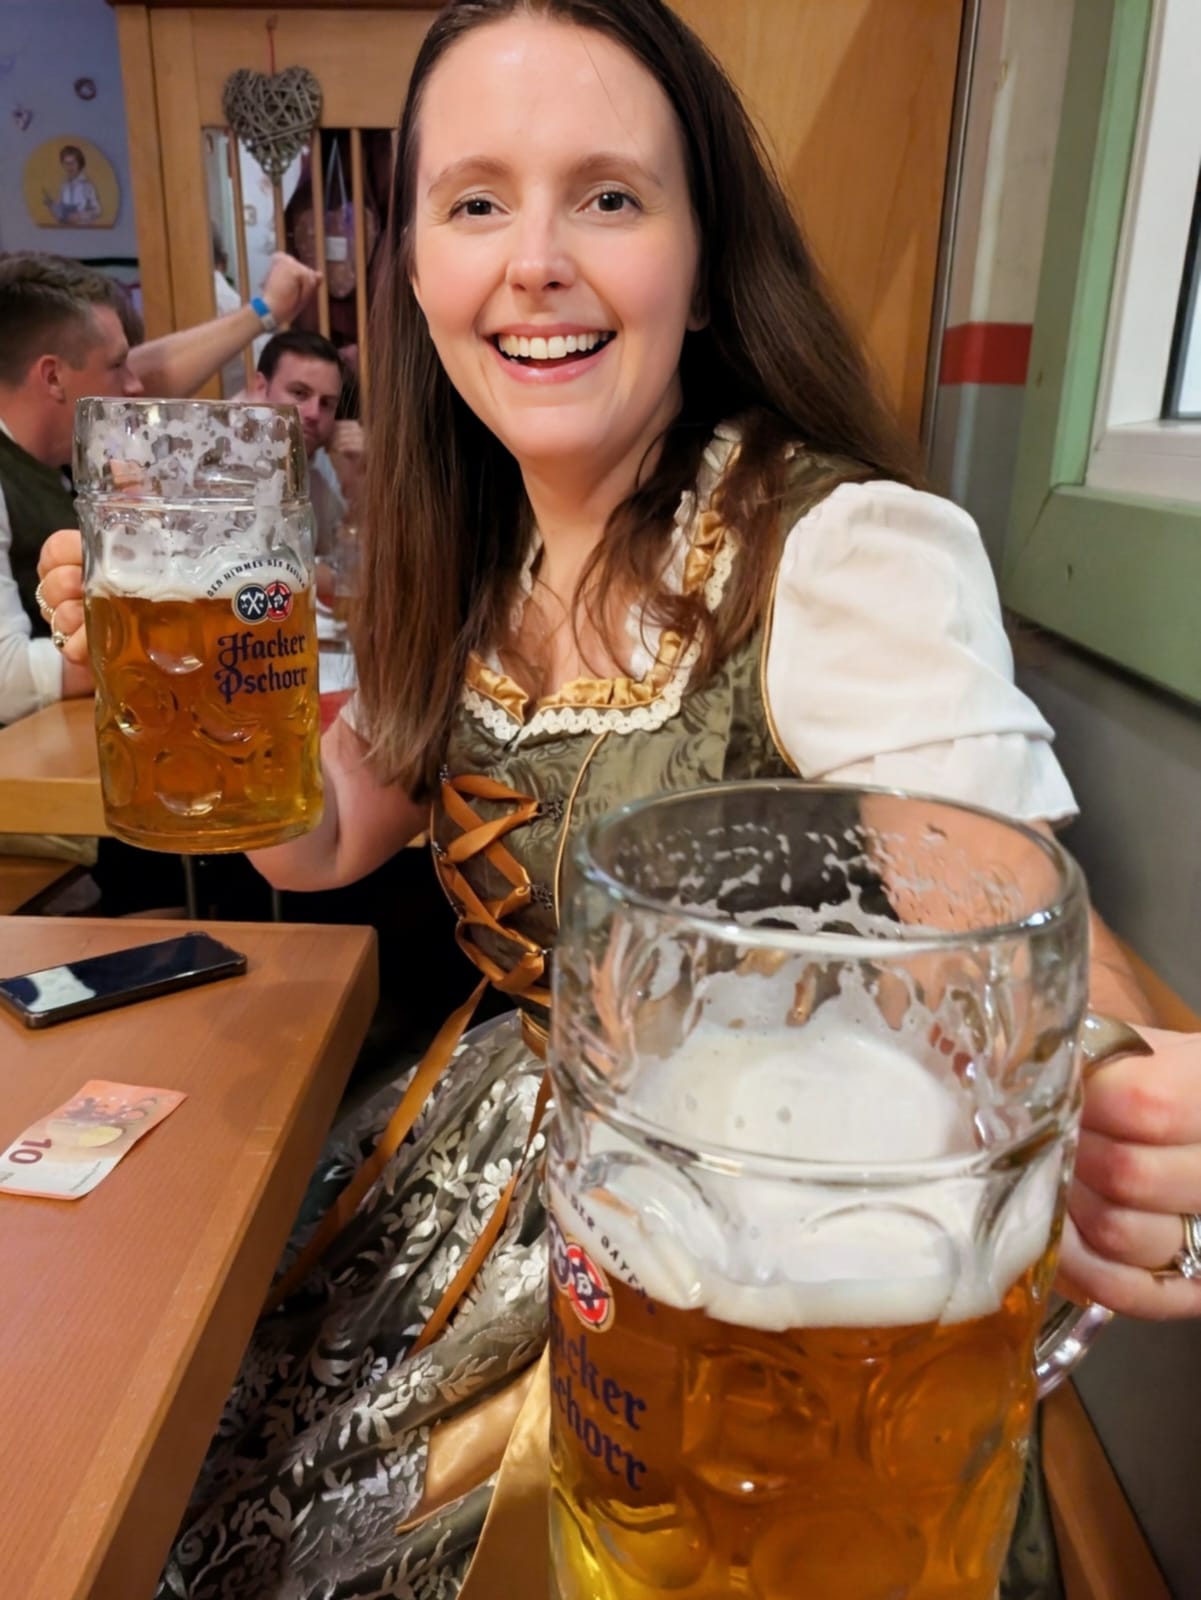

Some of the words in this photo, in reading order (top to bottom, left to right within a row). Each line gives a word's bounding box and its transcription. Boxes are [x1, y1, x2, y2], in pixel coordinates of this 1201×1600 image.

[217, 627, 306, 668] Hacker
[214, 662, 308, 704] Pschorr
[8, 1137, 53, 1165] 10
[555, 1328, 647, 1431] cker
[551, 1375, 648, 1492] chorr
